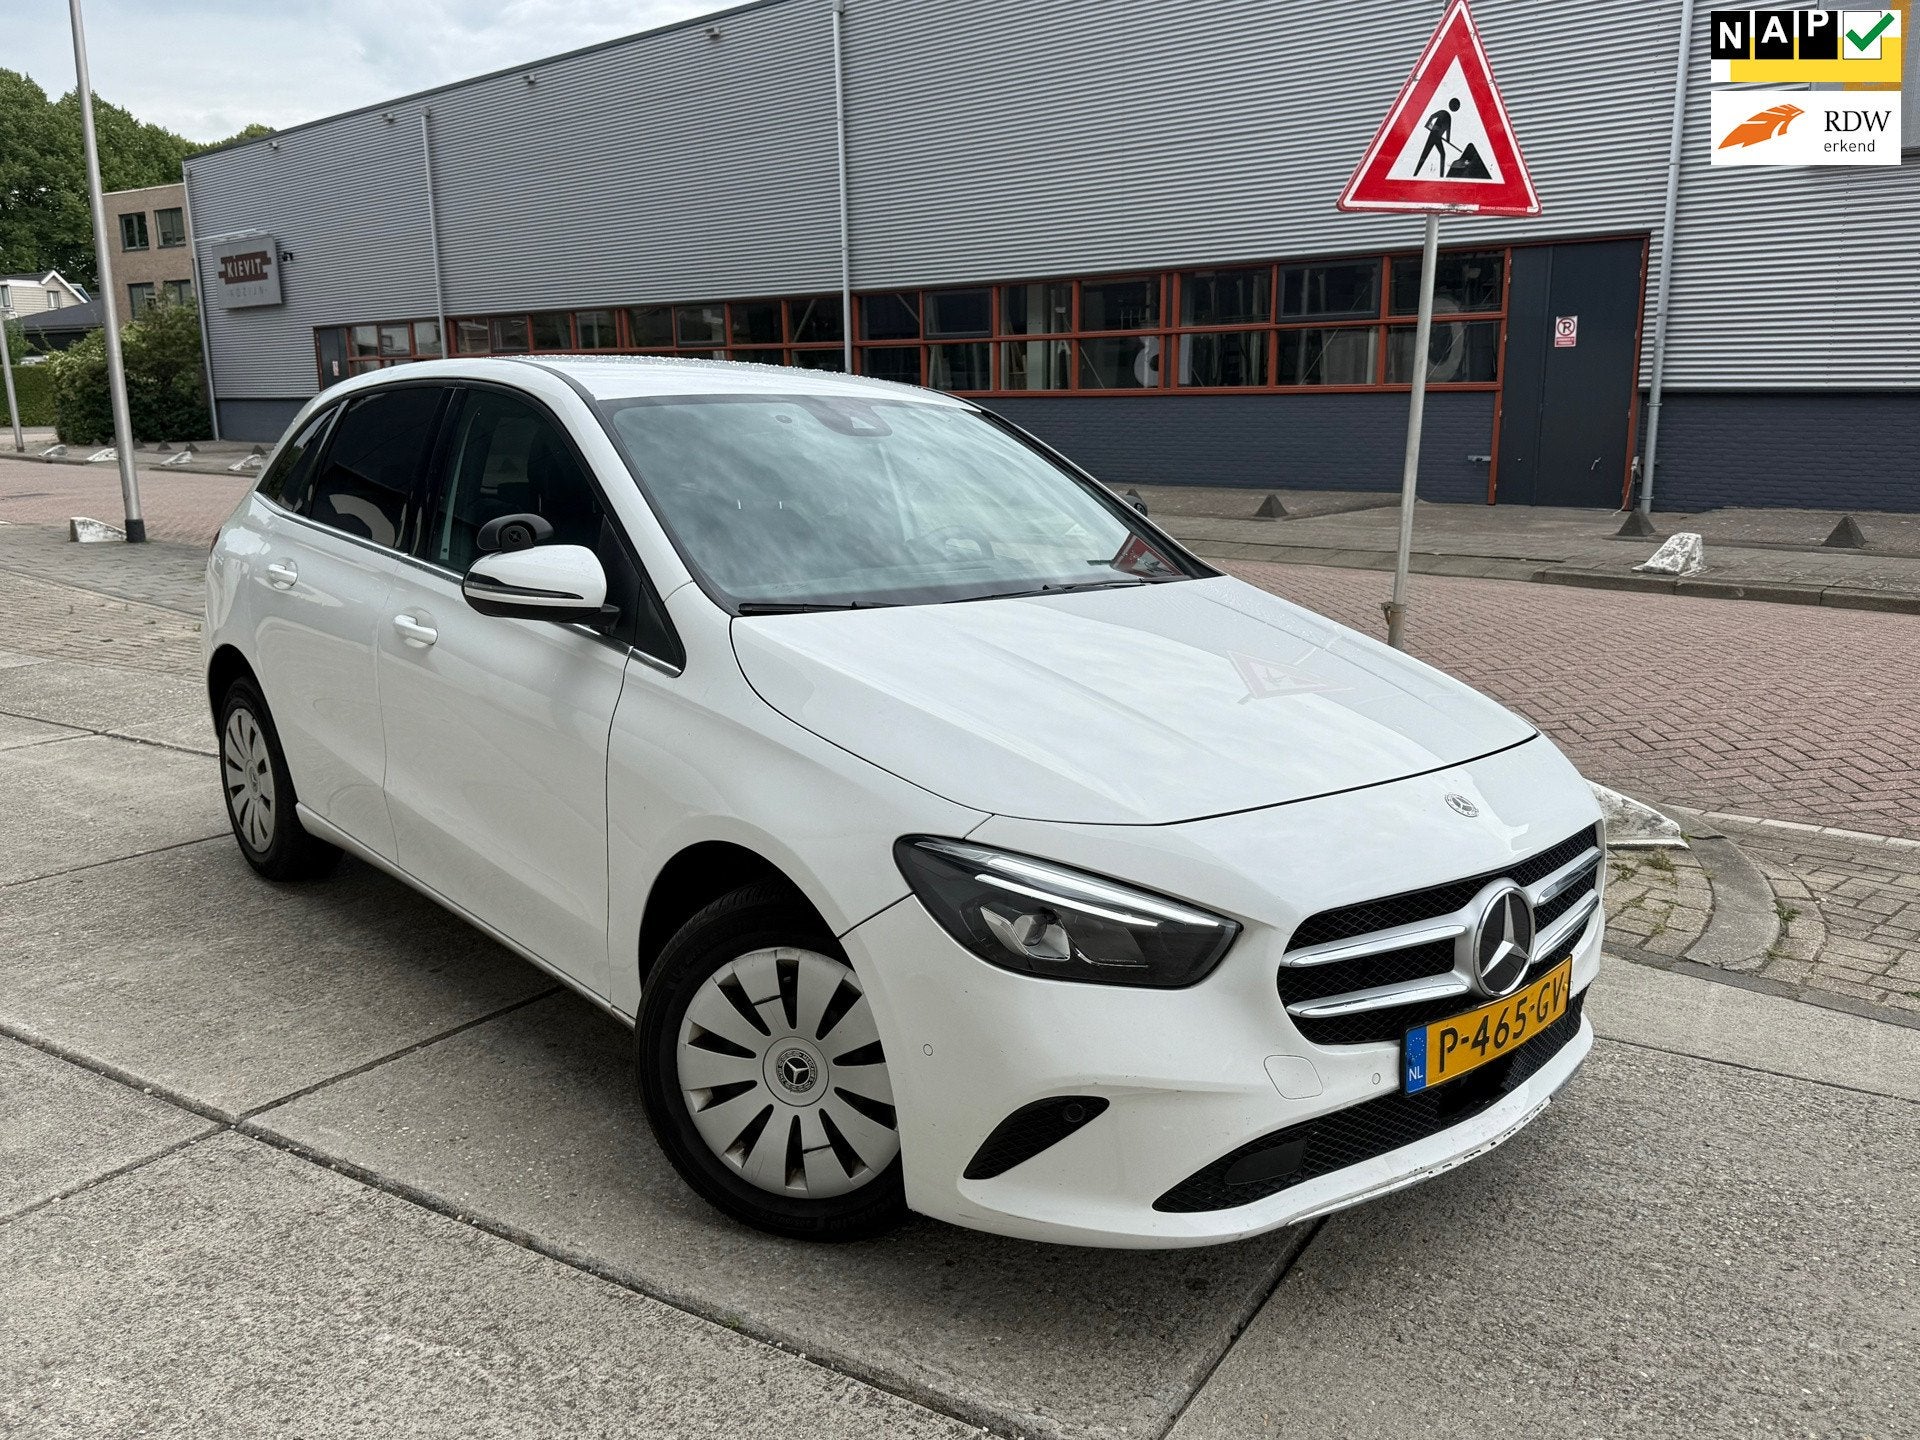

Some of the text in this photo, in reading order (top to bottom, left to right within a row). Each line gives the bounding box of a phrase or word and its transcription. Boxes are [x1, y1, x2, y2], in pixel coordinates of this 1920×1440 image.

[227, 258, 261, 278] KIEVIT
[1439, 971, 1564, 1073] P-465-GV
[1409, 1066, 1423, 1081] NL
